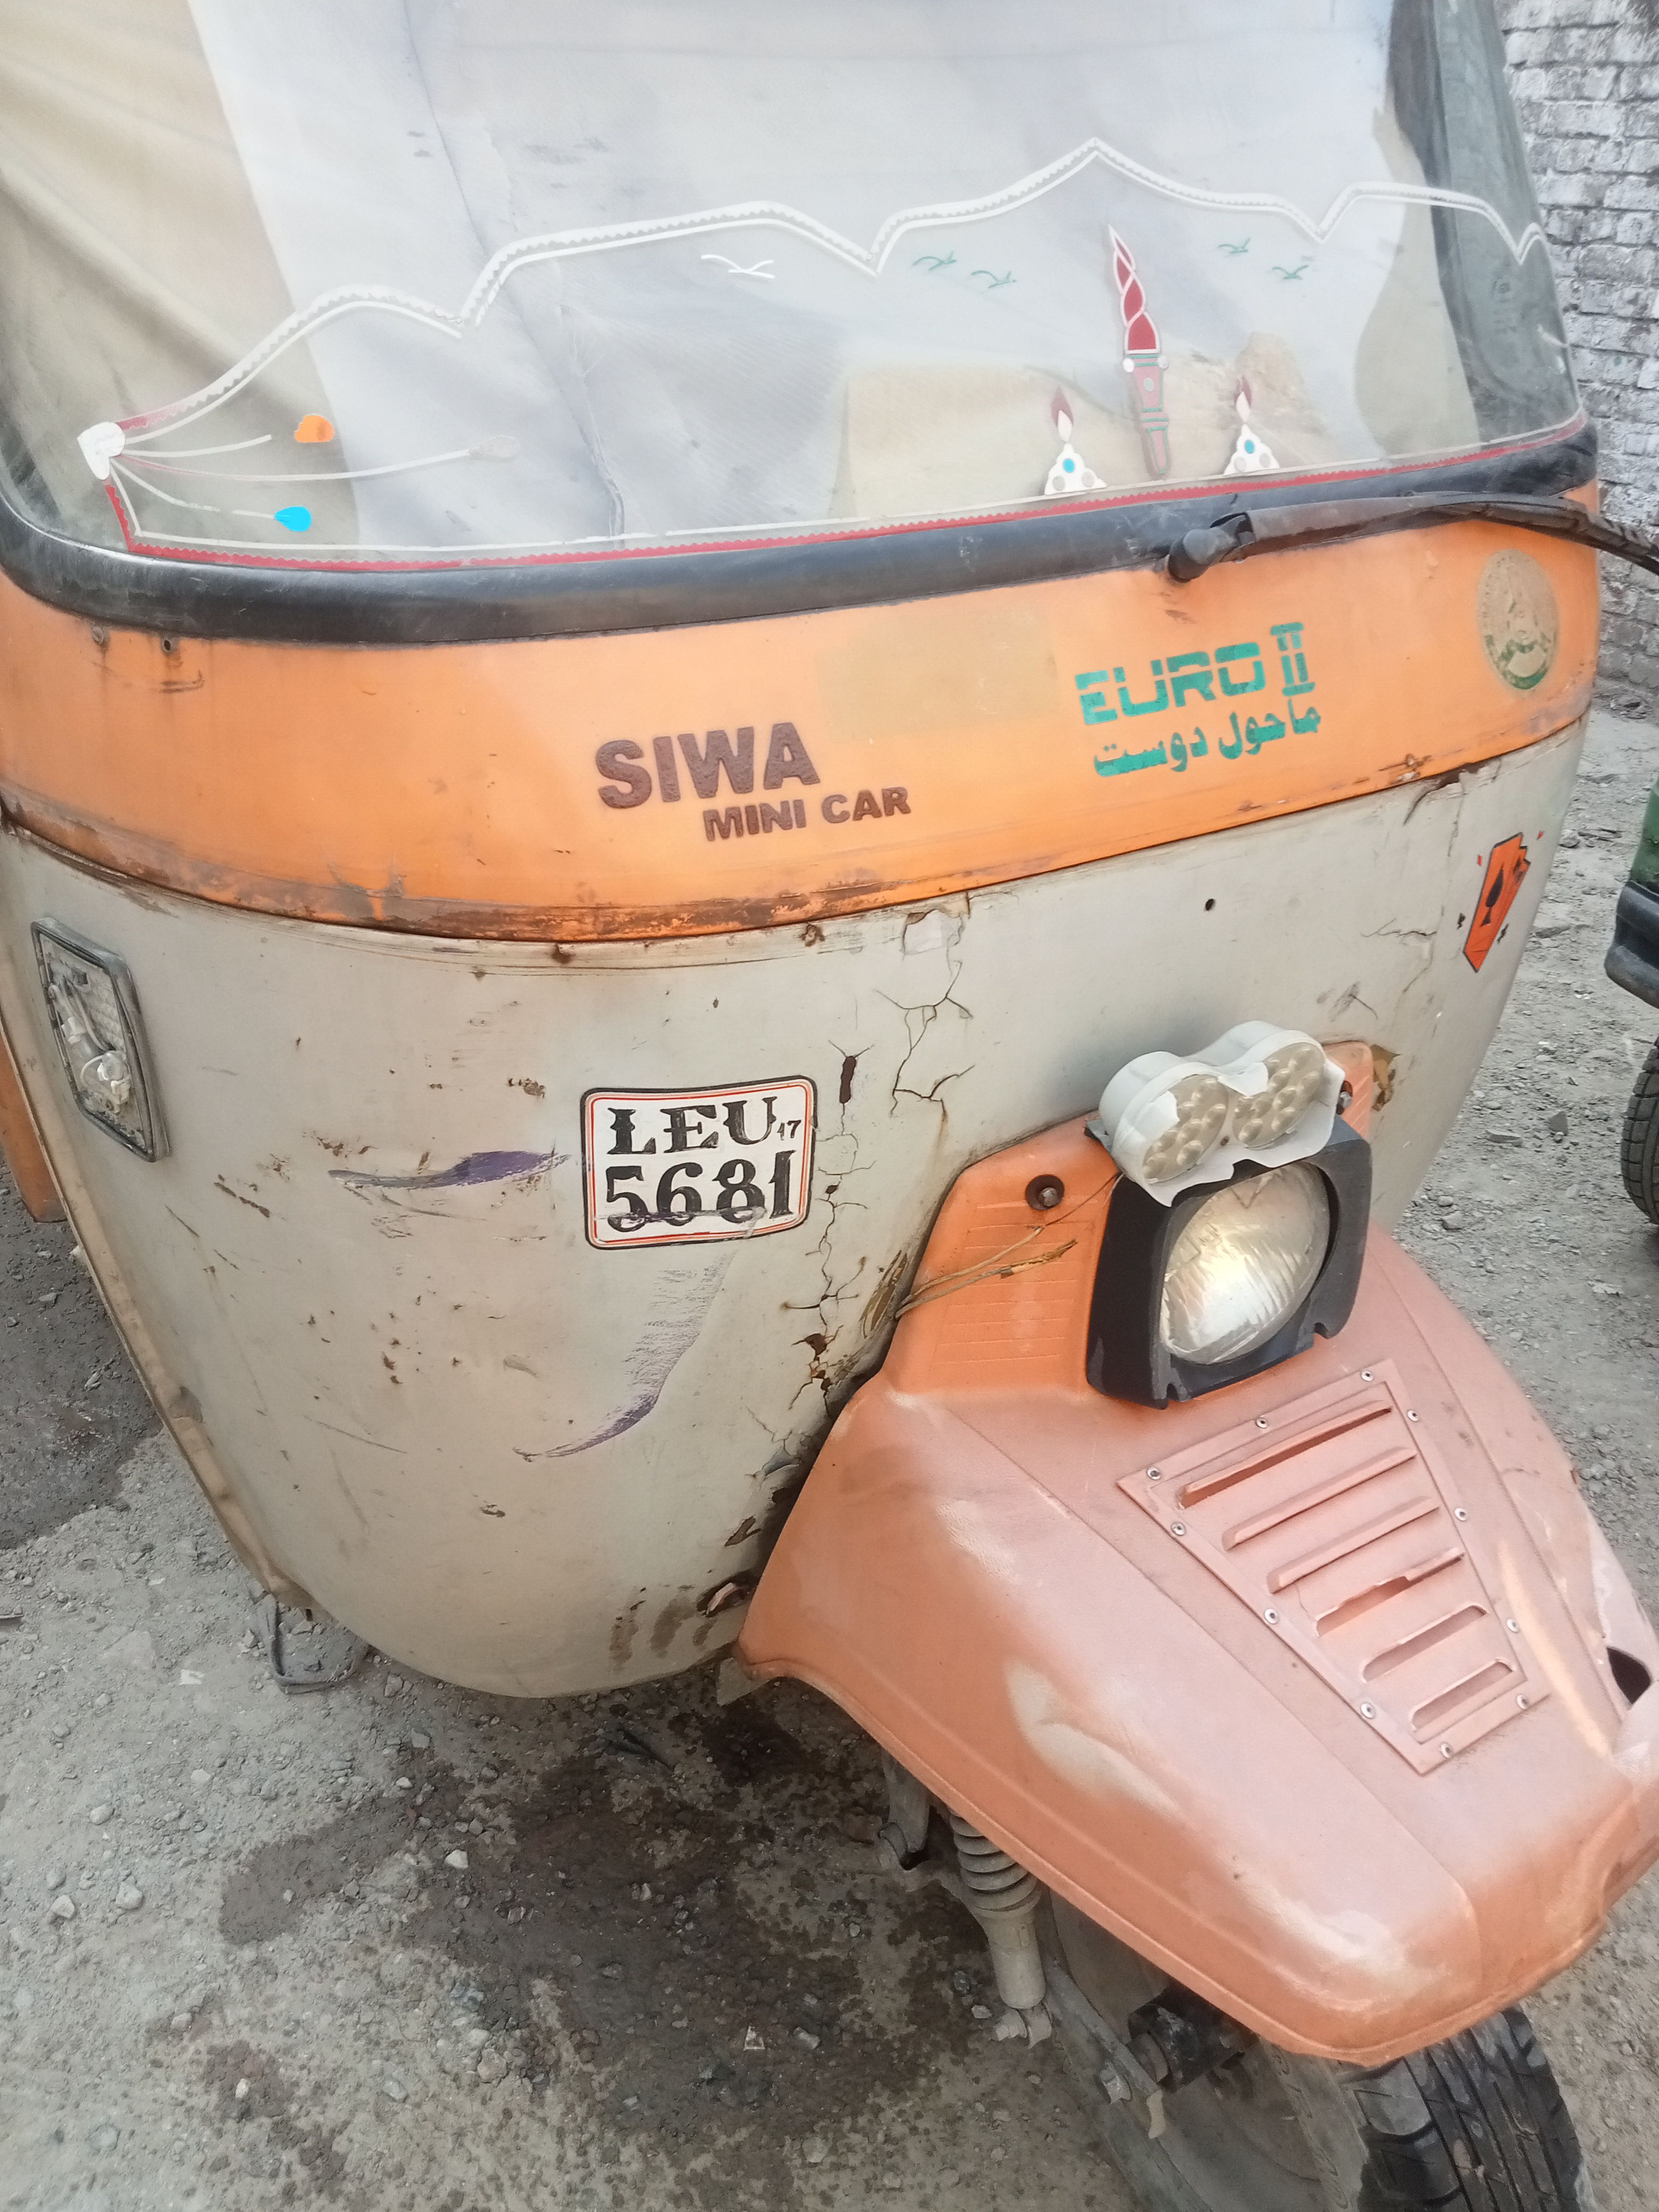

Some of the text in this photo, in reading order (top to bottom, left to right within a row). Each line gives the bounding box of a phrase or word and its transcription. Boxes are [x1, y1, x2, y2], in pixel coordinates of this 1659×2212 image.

[1075, 622, 1316, 725] EURO II
[595, 722, 820, 809] SIWA
[1093, 699, 1322, 777] ماحول دوست
[702, 786, 911, 841] MINI CAR
[607, 1096, 802, 1154] LEU 17
[606, 1150, 797, 1233] 5681
